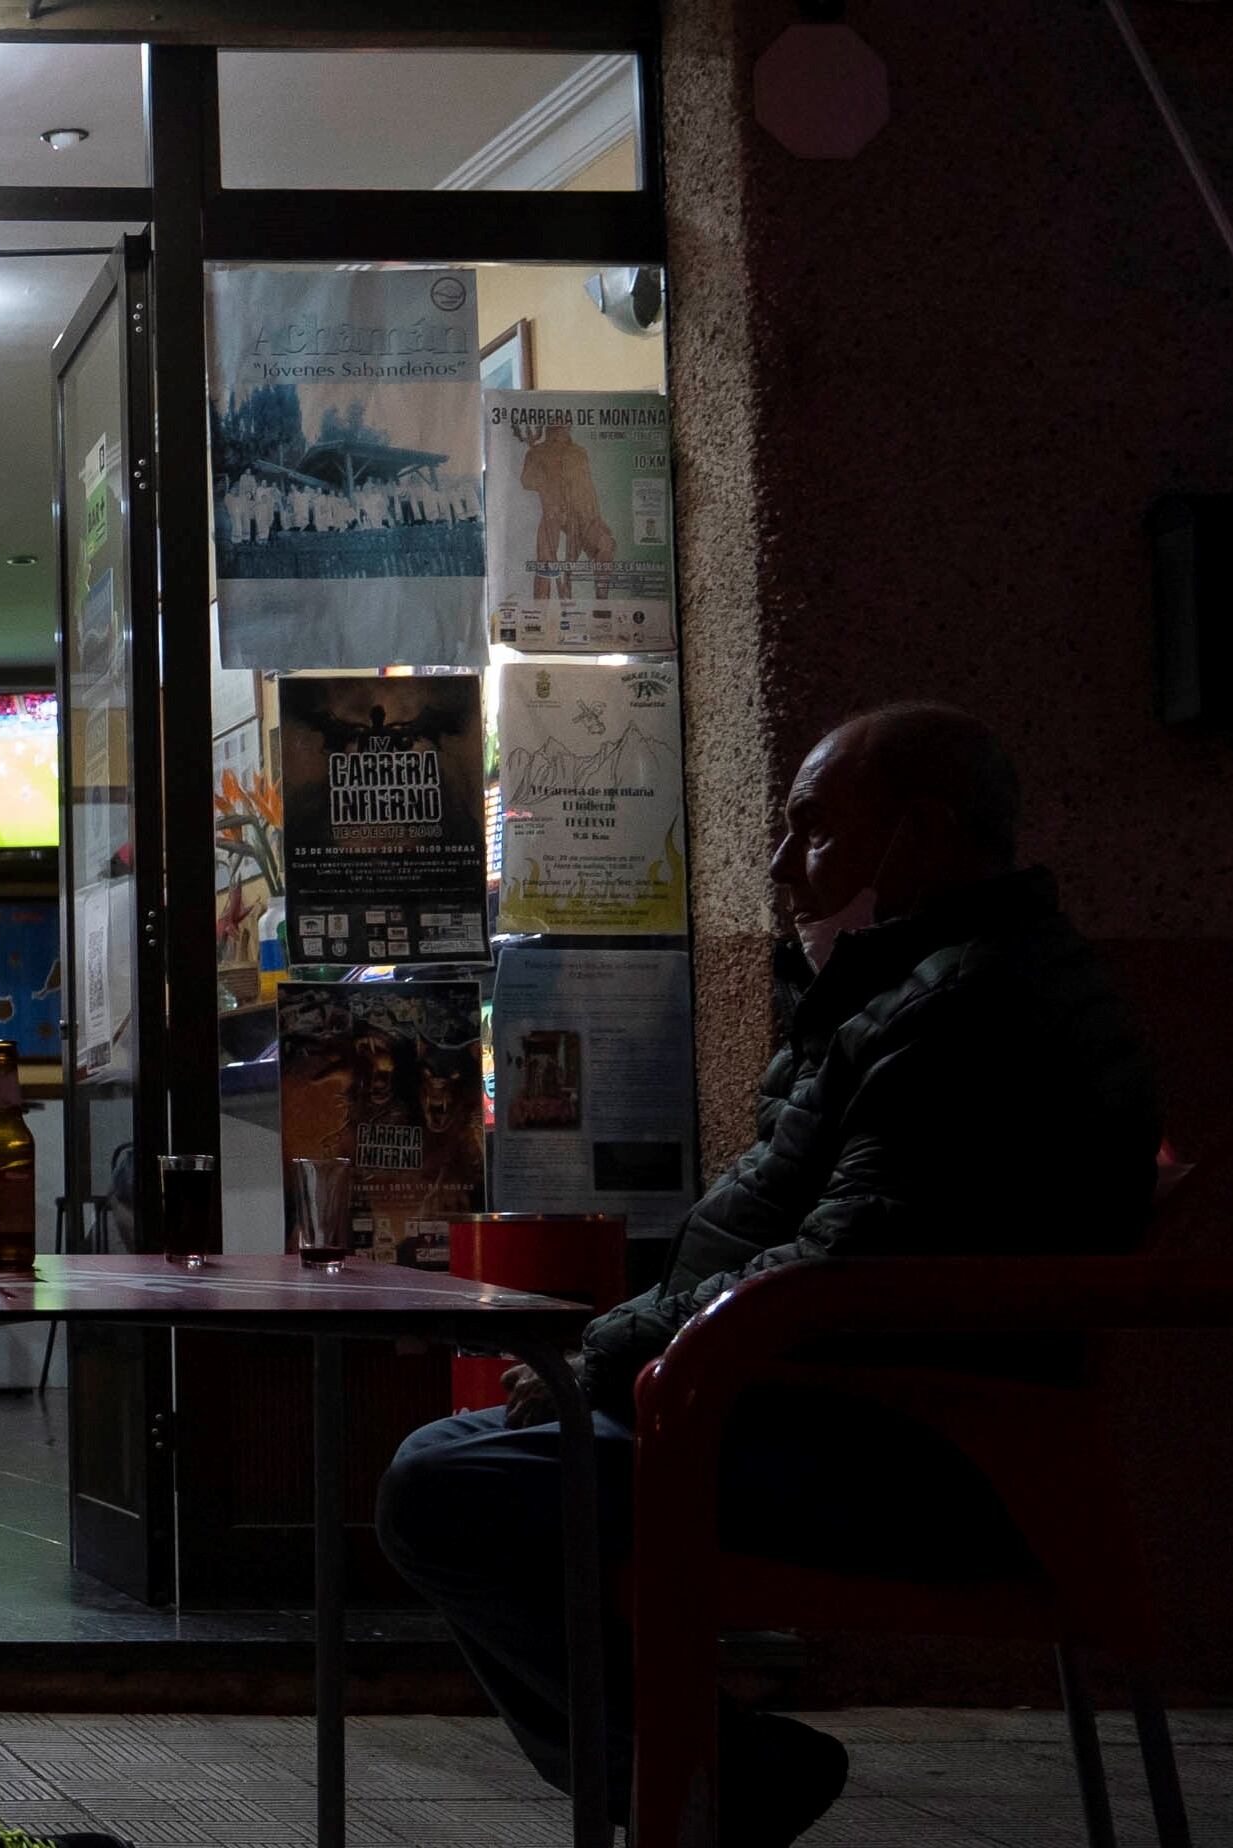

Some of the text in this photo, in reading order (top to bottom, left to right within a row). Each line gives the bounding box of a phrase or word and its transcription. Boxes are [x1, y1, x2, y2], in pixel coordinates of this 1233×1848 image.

[511, 408, 573, 425] CARRERA
[577, 409, 595, 426] DE
[330, 751, 440, 786] CARRERA
[331, 786, 442, 825] INFIERNO
[332, 825, 404, 840] TEGUESTE
[310, 847, 322, 855] DE
[357, 1122, 423, 1148] CARRERA
